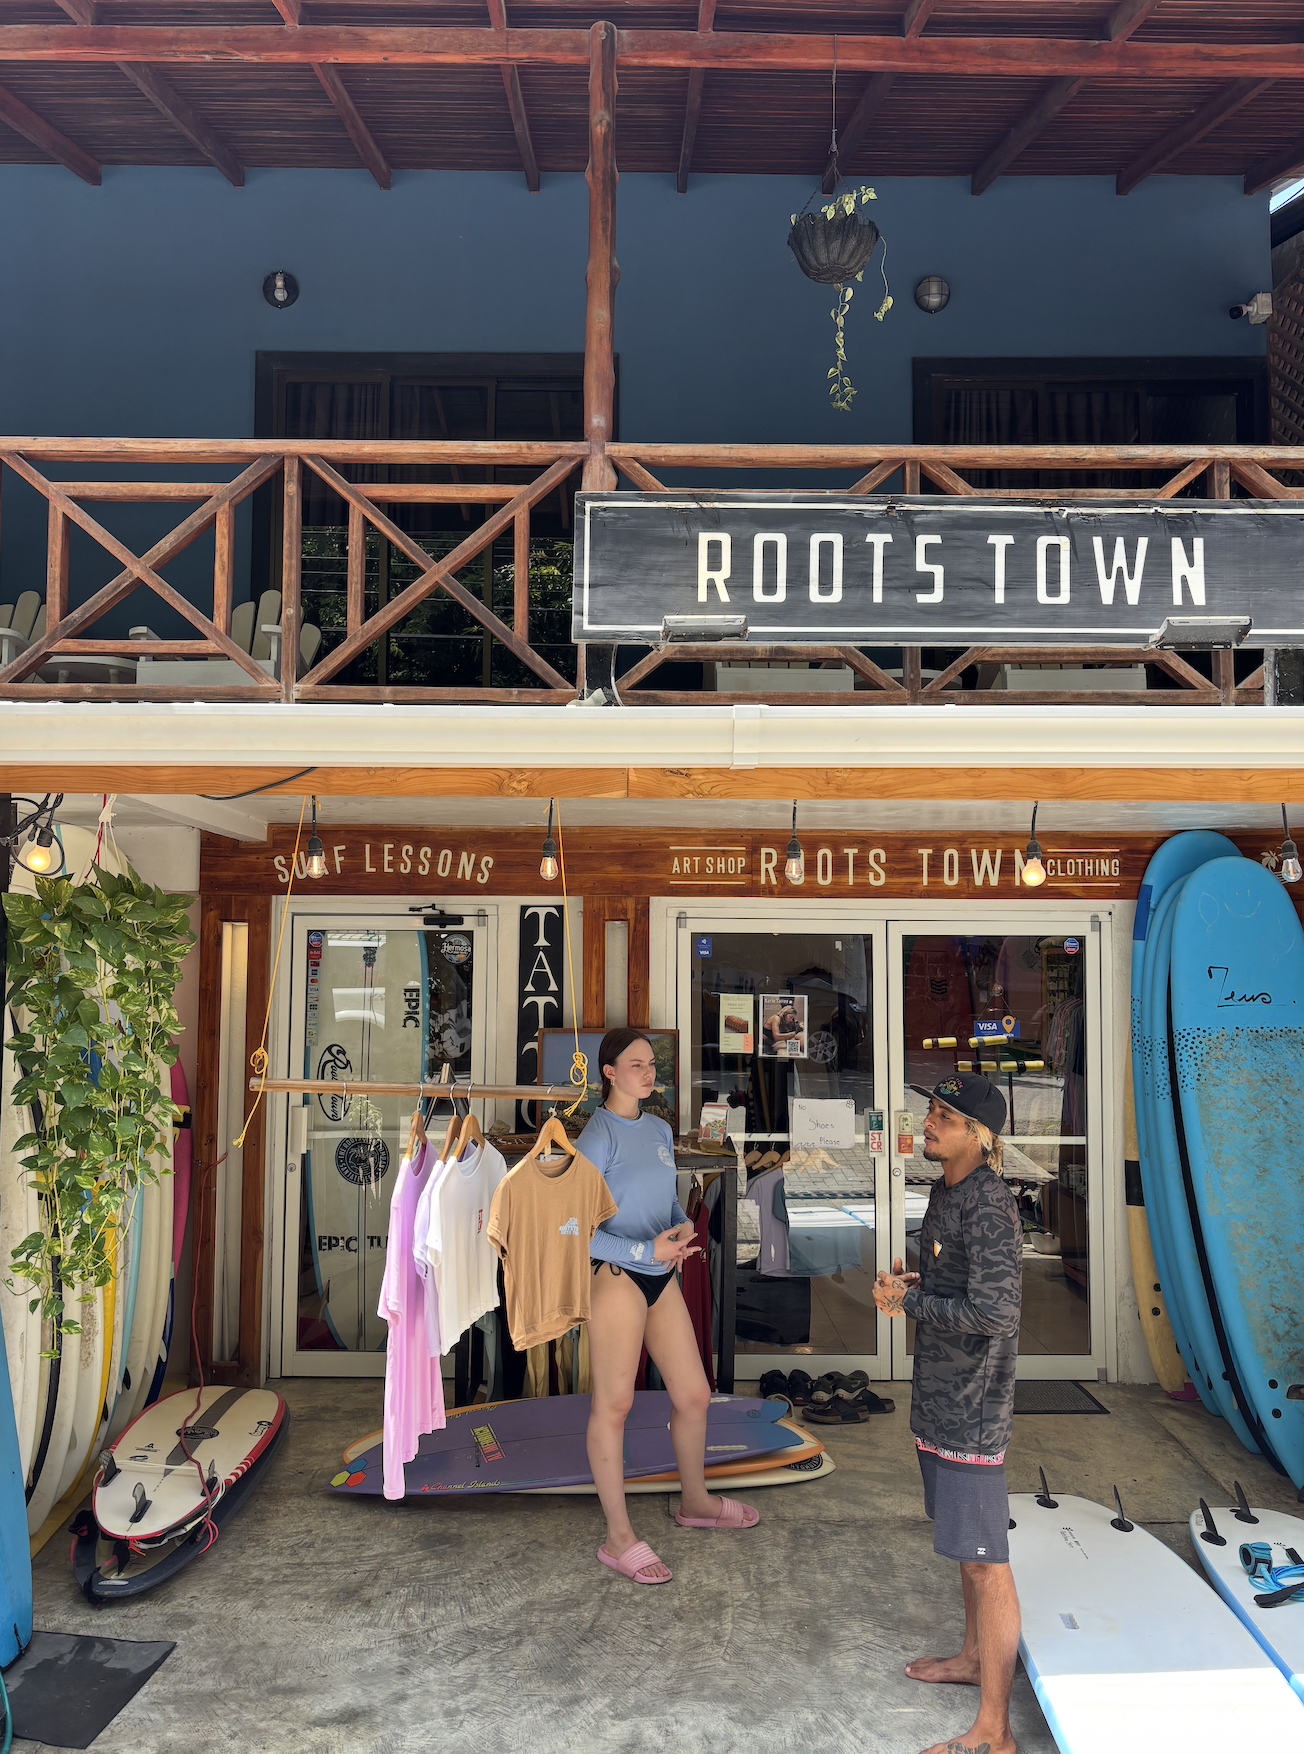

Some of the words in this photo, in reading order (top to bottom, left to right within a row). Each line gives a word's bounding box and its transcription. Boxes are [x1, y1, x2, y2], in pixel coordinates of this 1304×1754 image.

[697, 532, 945, 603] ROOTS
[986, 534, 1206, 606] TOWN
[364, 843, 494, 884] LESSONS
[671, 856, 700, 874] ART
[705, 856, 746, 875] SHOP
[1046, 858, 1120, 877] CLOTHING
[402, 988, 420, 1028] EPIC
[977, 1022, 998, 1031] VISA
[808, 1117, 835, 1131] Shoes
[819, 1136, 840, 1146] Please
[870, 1132, 883, 1141] ST
[870, 1141, 883, 1151] CR
[317, 1235, 358, 1253] EPIC
[430, 1481, 466, 1491] Channel
[467, 1480, 501, 1489] Islands
